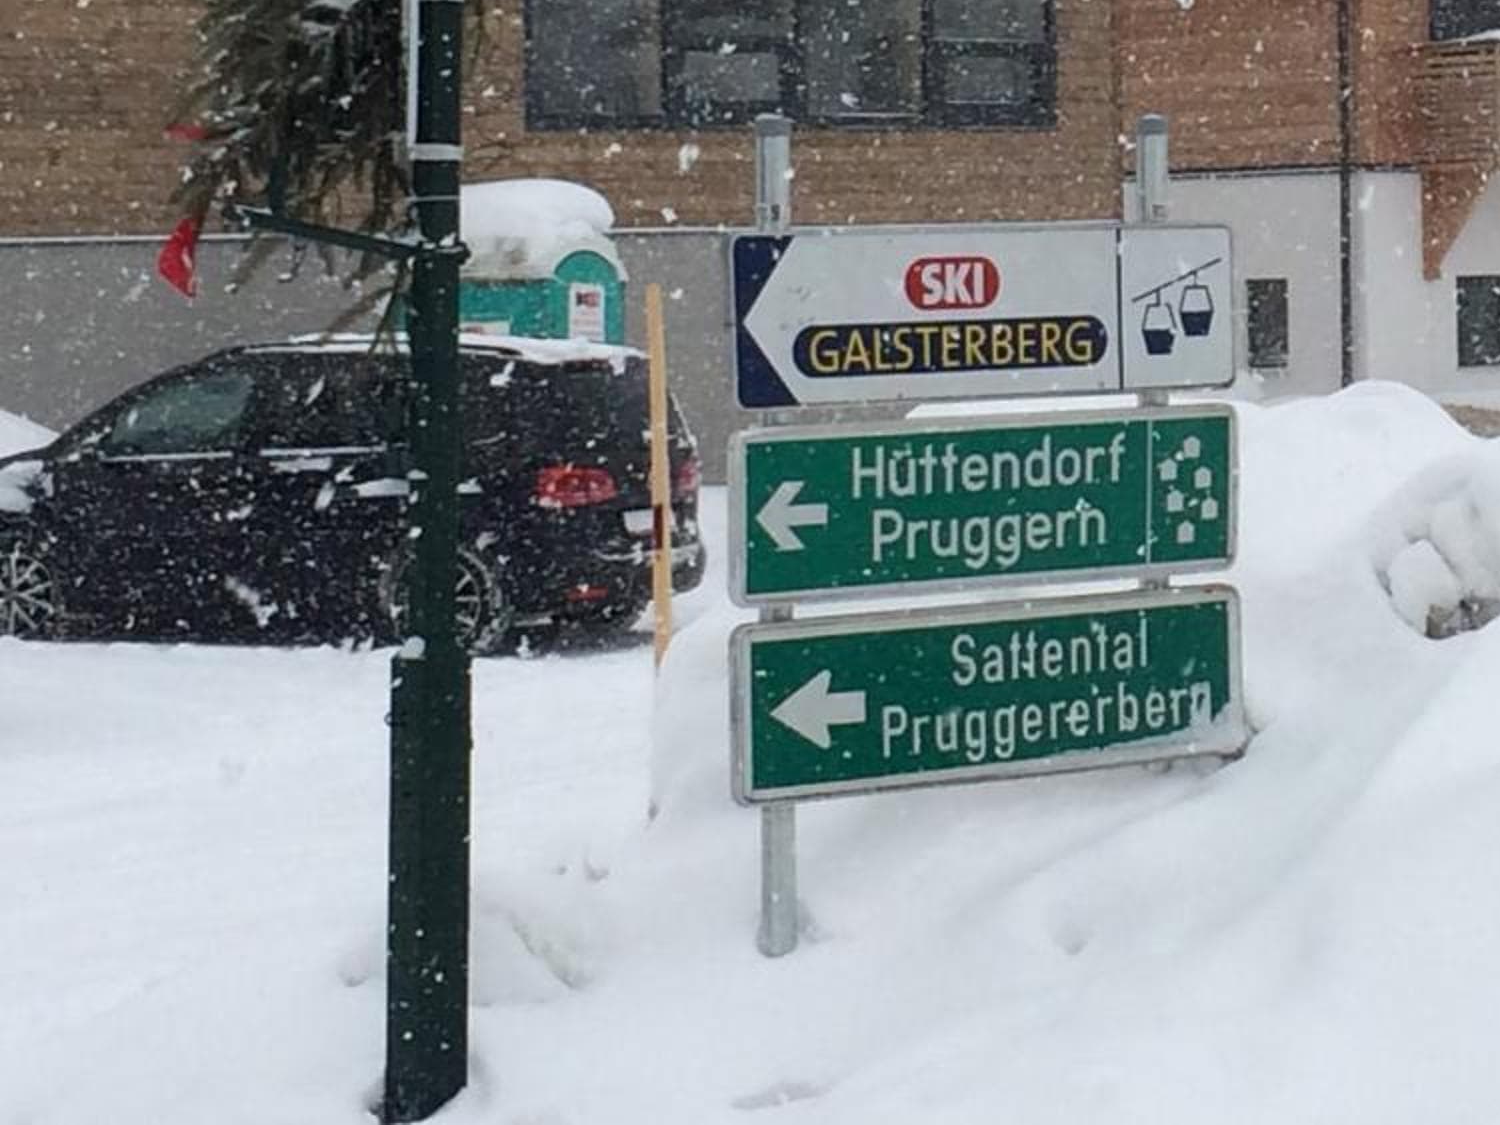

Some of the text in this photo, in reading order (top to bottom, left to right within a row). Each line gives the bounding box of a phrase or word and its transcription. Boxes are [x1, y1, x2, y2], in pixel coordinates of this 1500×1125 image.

[921, 262, 986, 305] SKI
[808, 321, 1094, 373] GALSTERBERG
[851, 433, 1126, 498] Hüttendorf
[871, 507, 1107, 567] Pruggern
[951, 614, 1149, 686] Sattental
